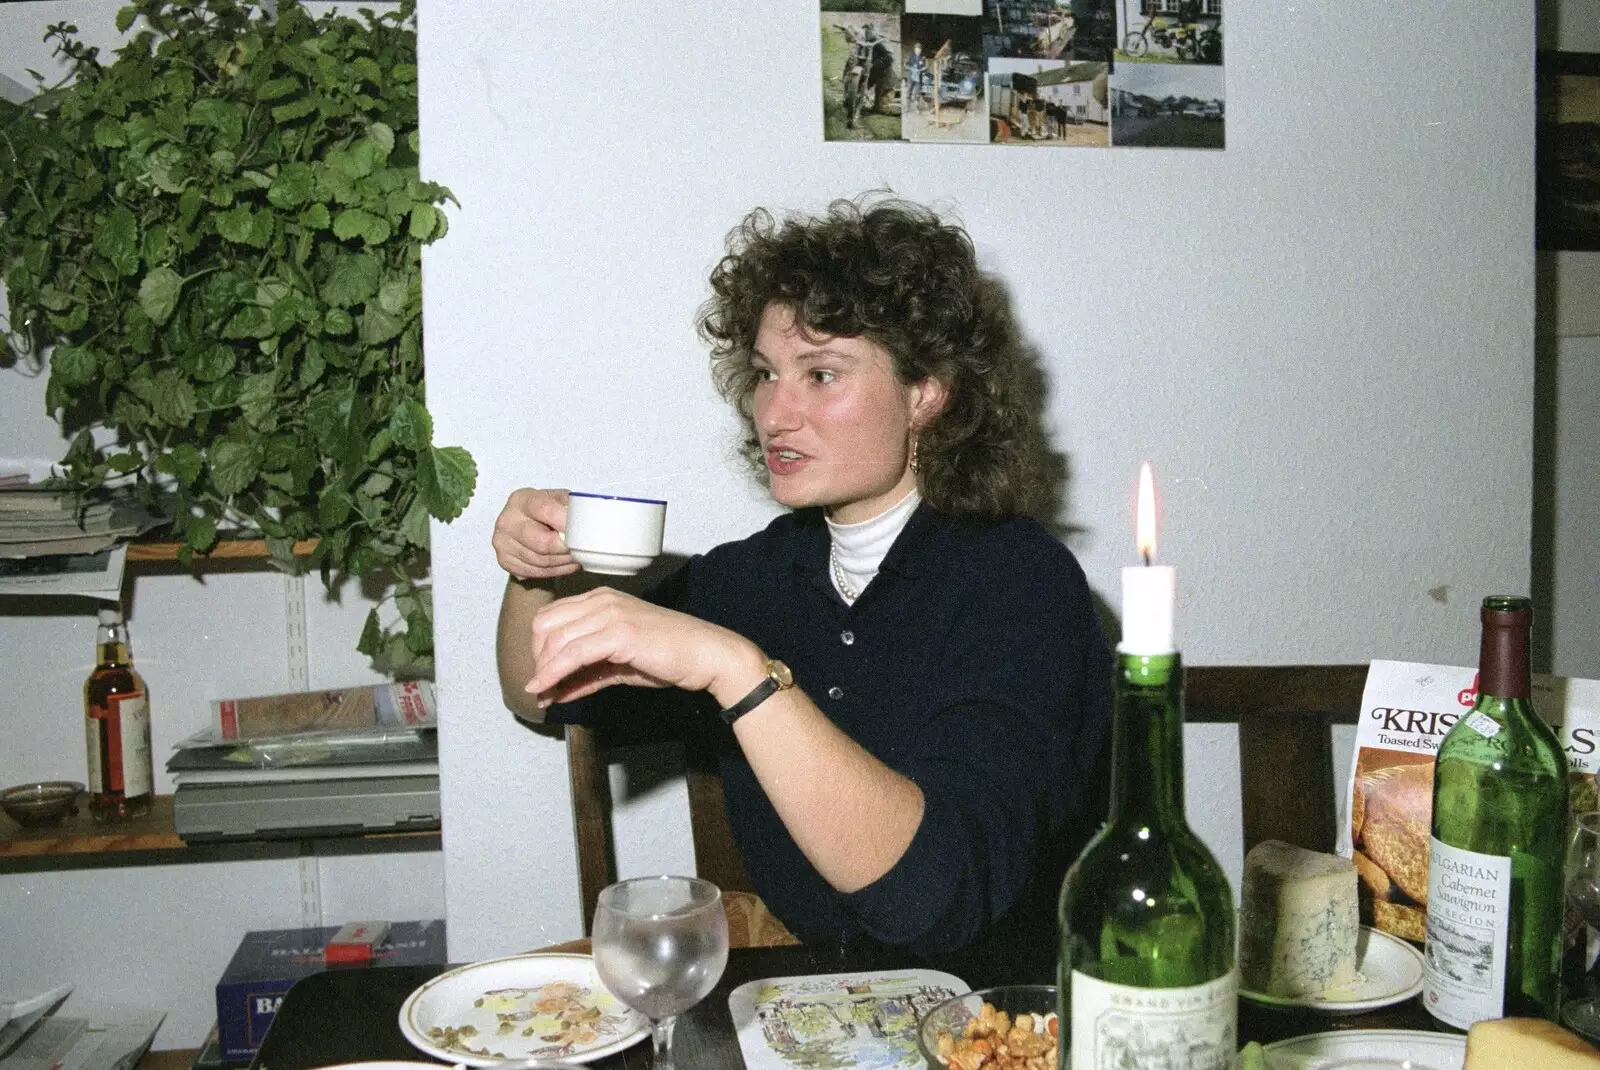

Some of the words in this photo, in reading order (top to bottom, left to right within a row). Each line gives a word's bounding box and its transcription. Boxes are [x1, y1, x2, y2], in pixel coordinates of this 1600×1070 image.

[1378, 733, 1421, 749] Toasted
[1441, 873, 1497, 899] Cabernet
[1436, 885, 1496, 914] Sauvignon
[1445, 908, 1496, 928] REGION
